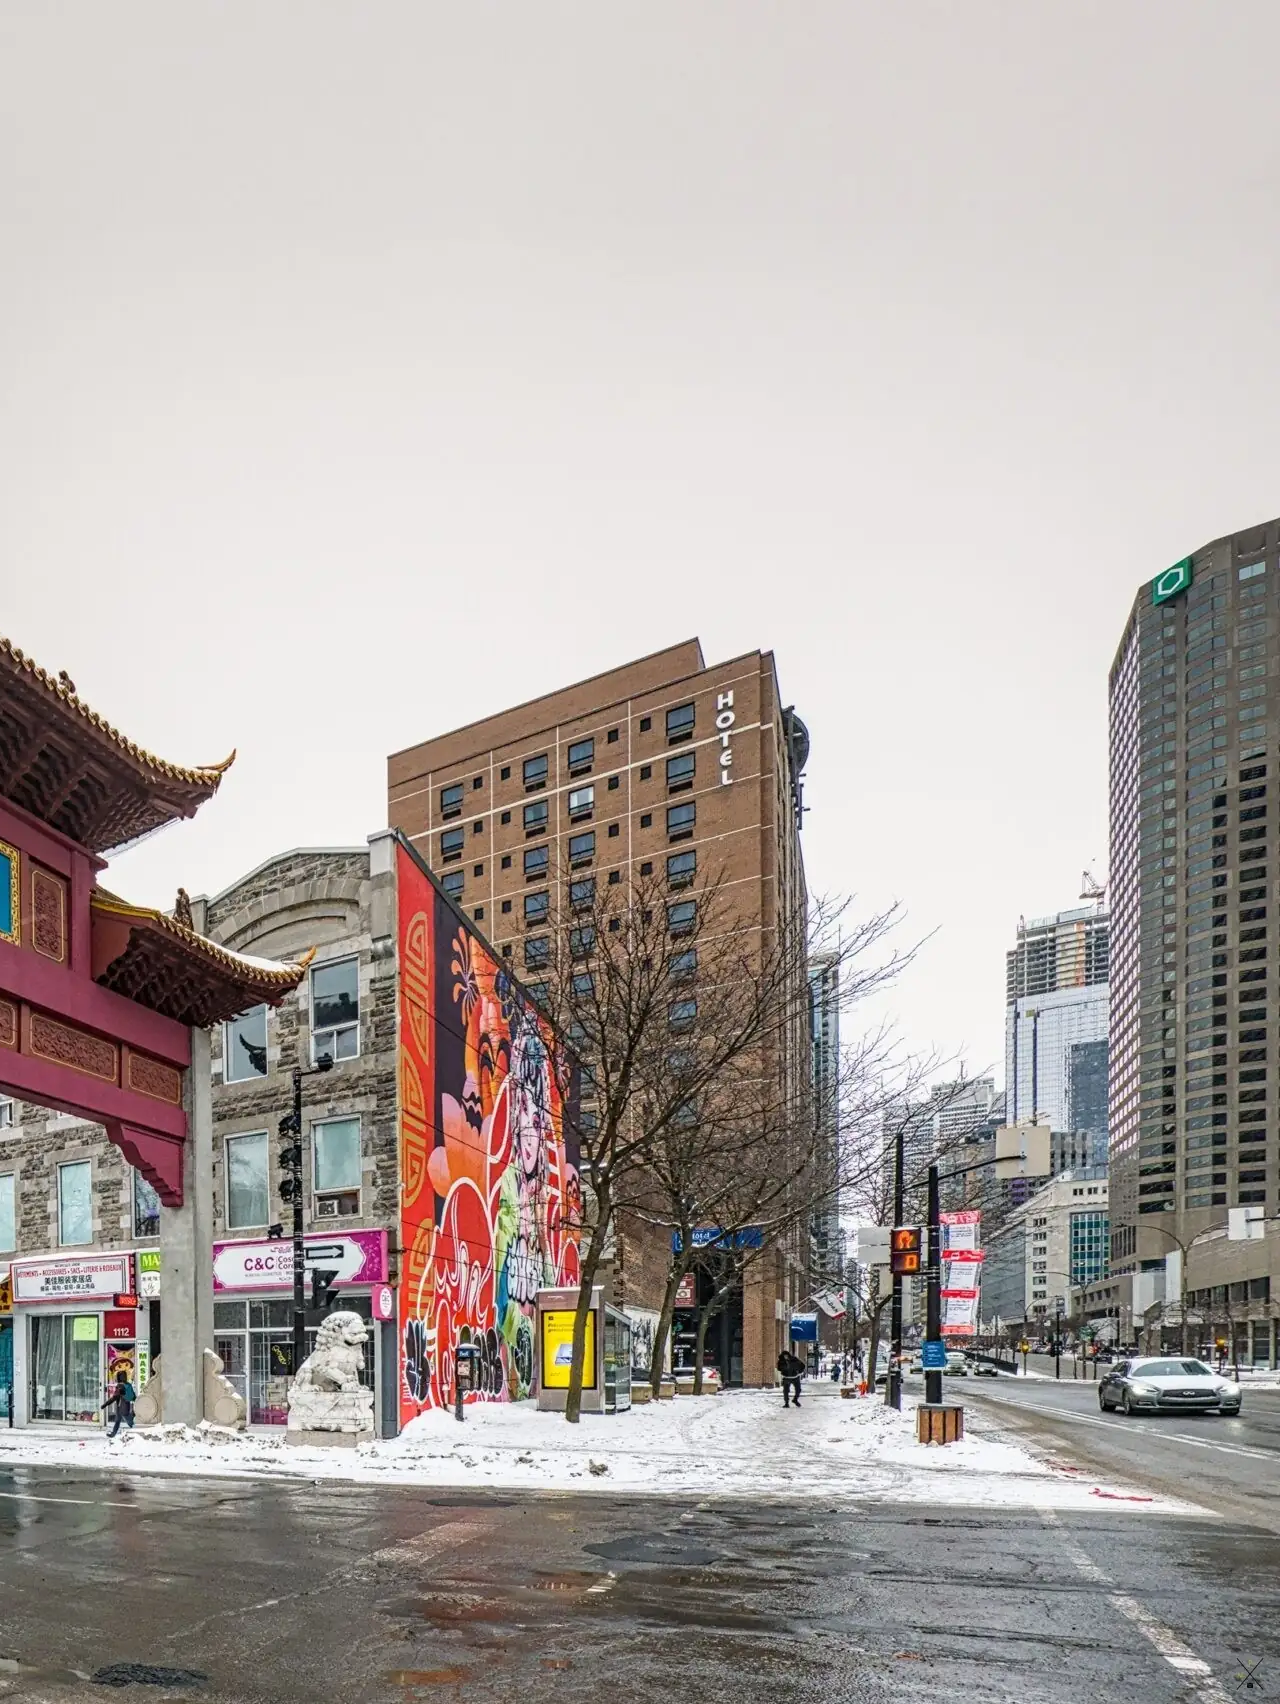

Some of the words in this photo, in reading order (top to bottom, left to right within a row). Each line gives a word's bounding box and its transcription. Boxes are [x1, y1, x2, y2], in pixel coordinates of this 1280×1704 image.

[715, 689, 735, 786] HOTEL
[142, 1254, 160, 1267] MA
[244, 1257, 274, 1271] C&C
[113, 1327, 129, 1337] 1112
